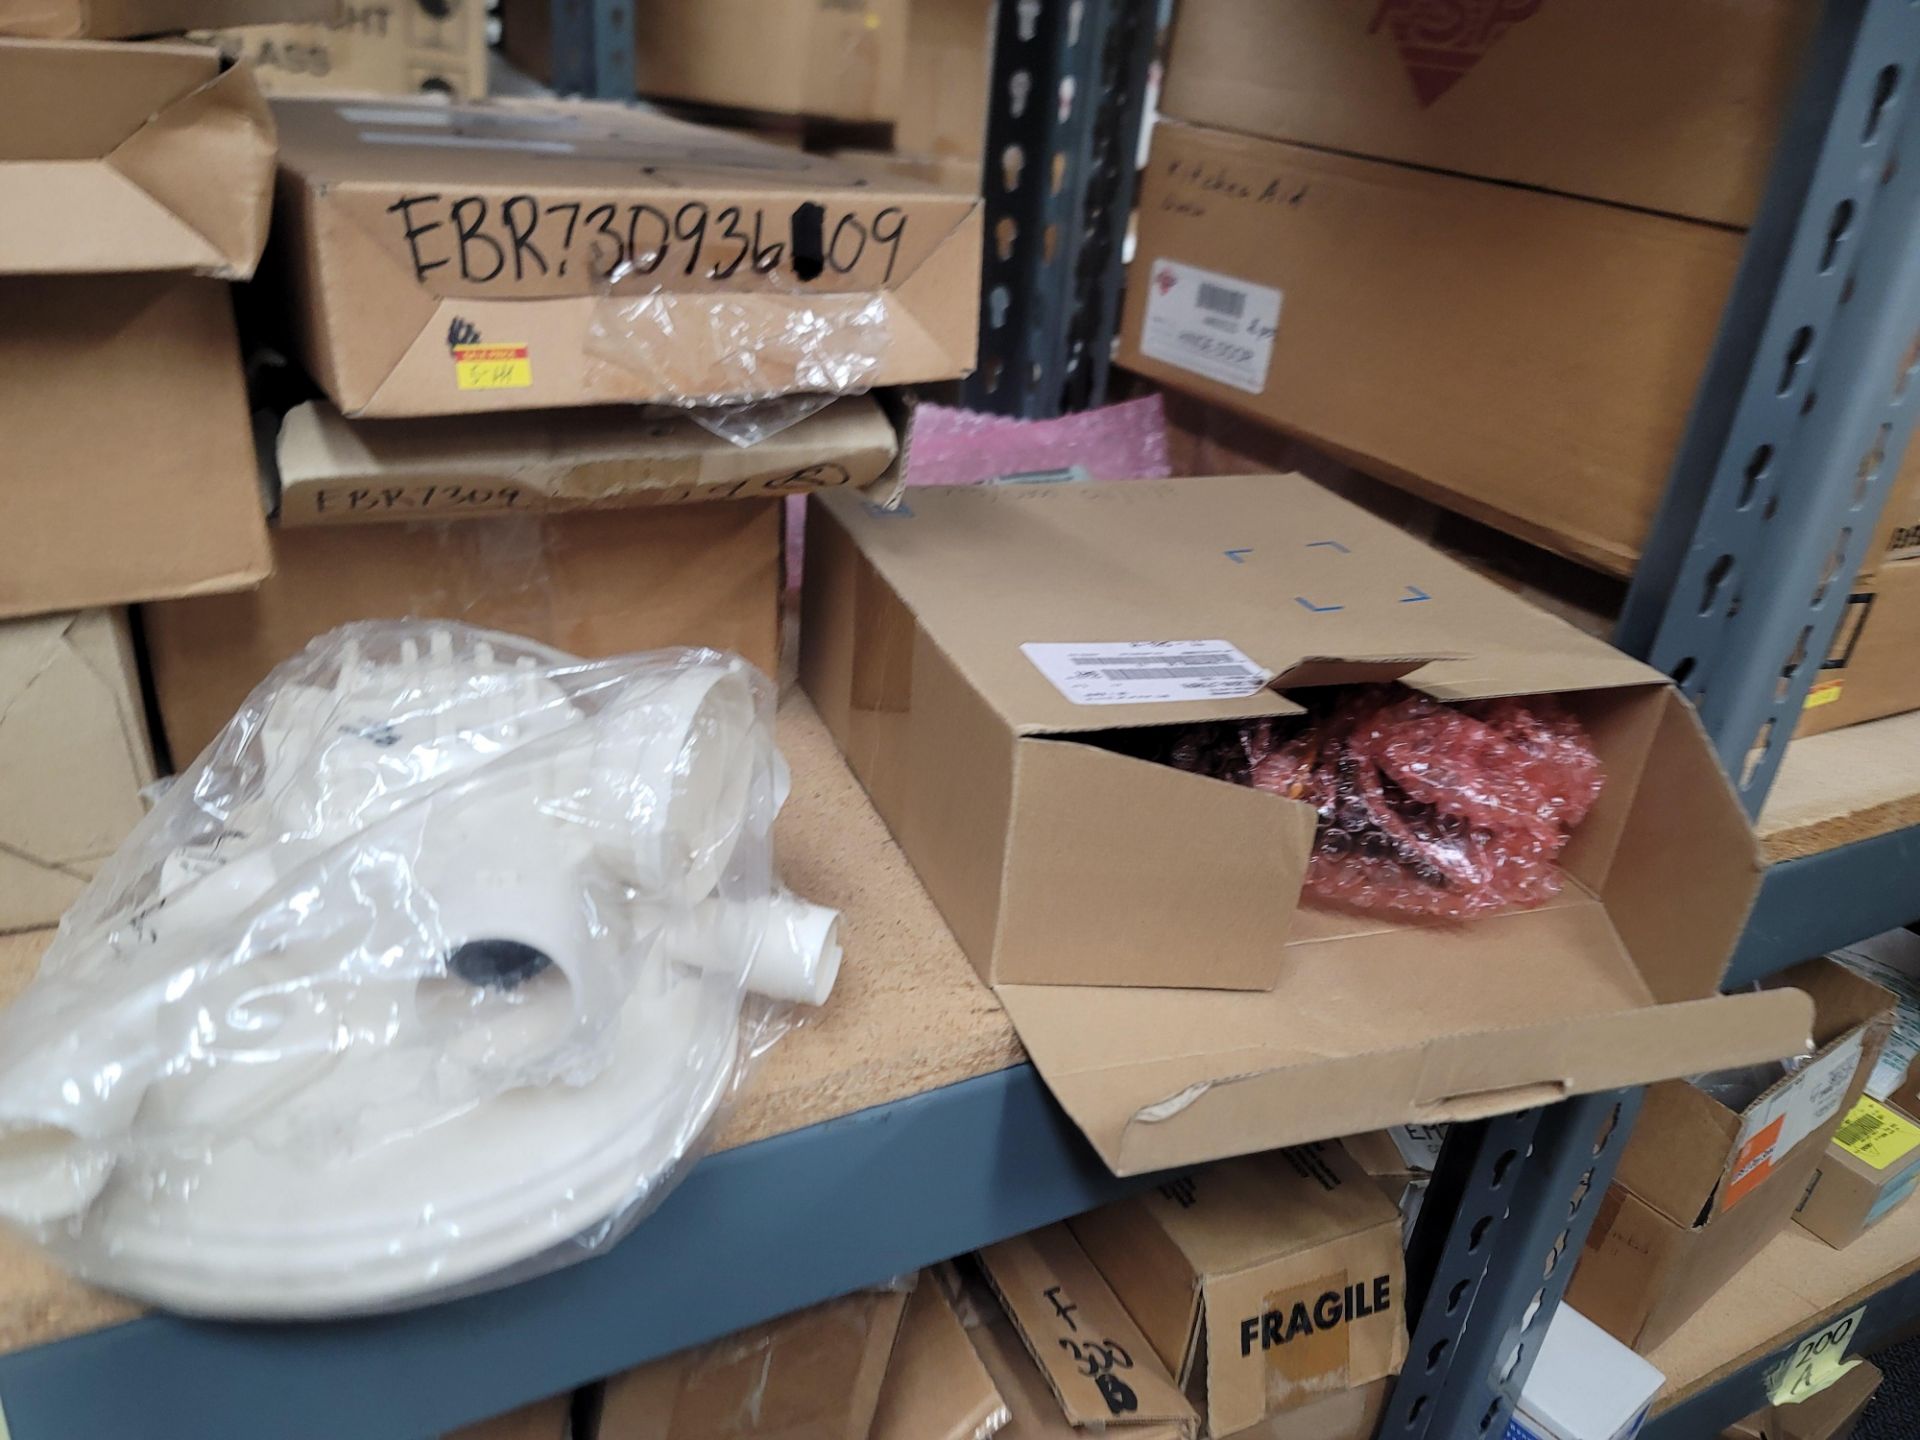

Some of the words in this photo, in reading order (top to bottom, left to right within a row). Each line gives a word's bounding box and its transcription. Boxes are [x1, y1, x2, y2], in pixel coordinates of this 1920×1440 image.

[387, 194, 907, 282] EBR73093609
[1240, 1274, 1391, 1358] FRAGILE
[1795, 1317, 1853, 1369] 200
